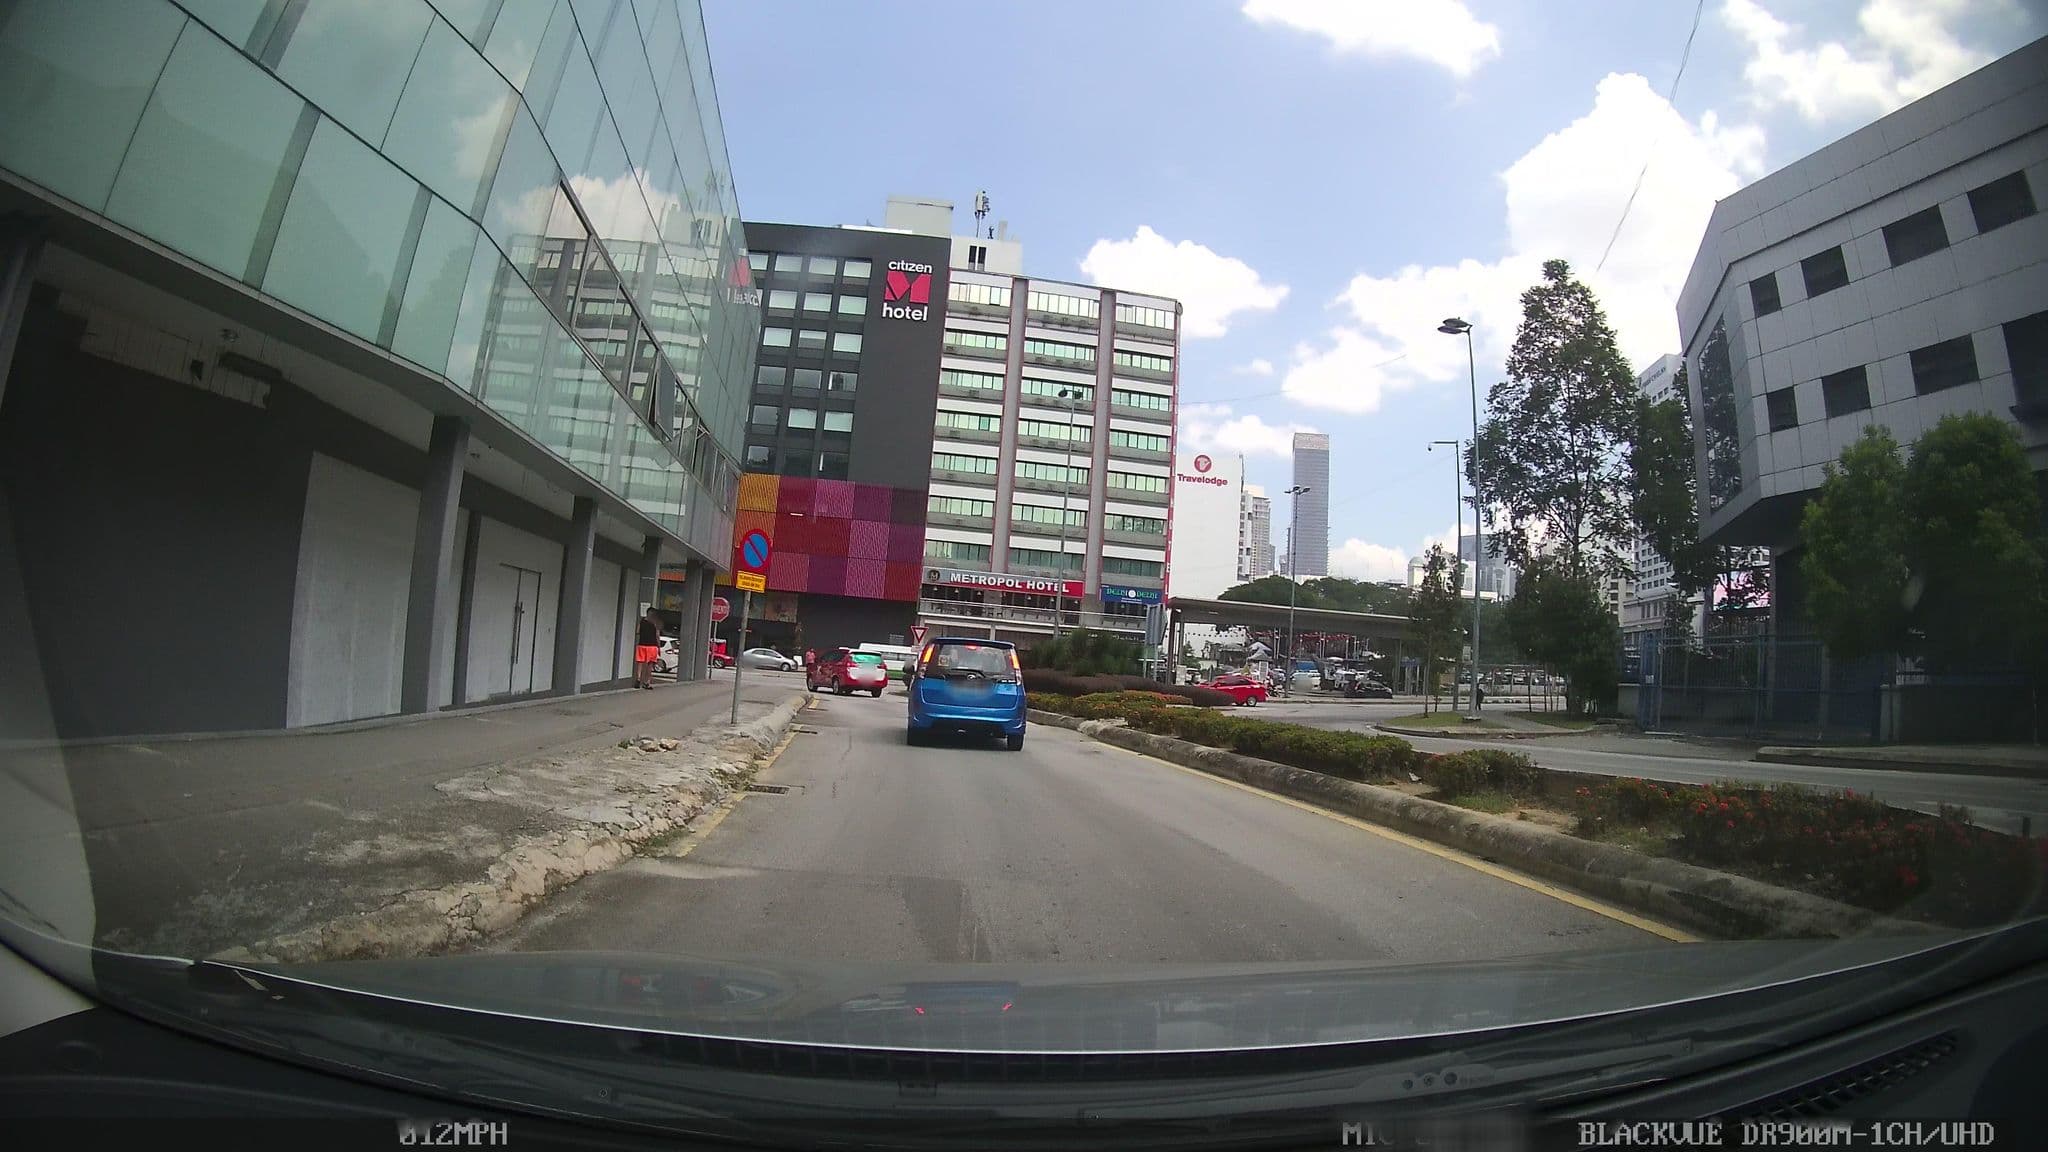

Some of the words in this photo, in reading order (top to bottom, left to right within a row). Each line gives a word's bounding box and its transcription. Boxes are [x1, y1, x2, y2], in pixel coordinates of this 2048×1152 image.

[888, 260, 932, 273] citizen
[882, 302, 928, 321] hotel
[1177, 473, 1228, 487] Travelodge
[950, 572, 1023, 589] METROPOL
[1026, 580, 1069, 593] HOTEL
